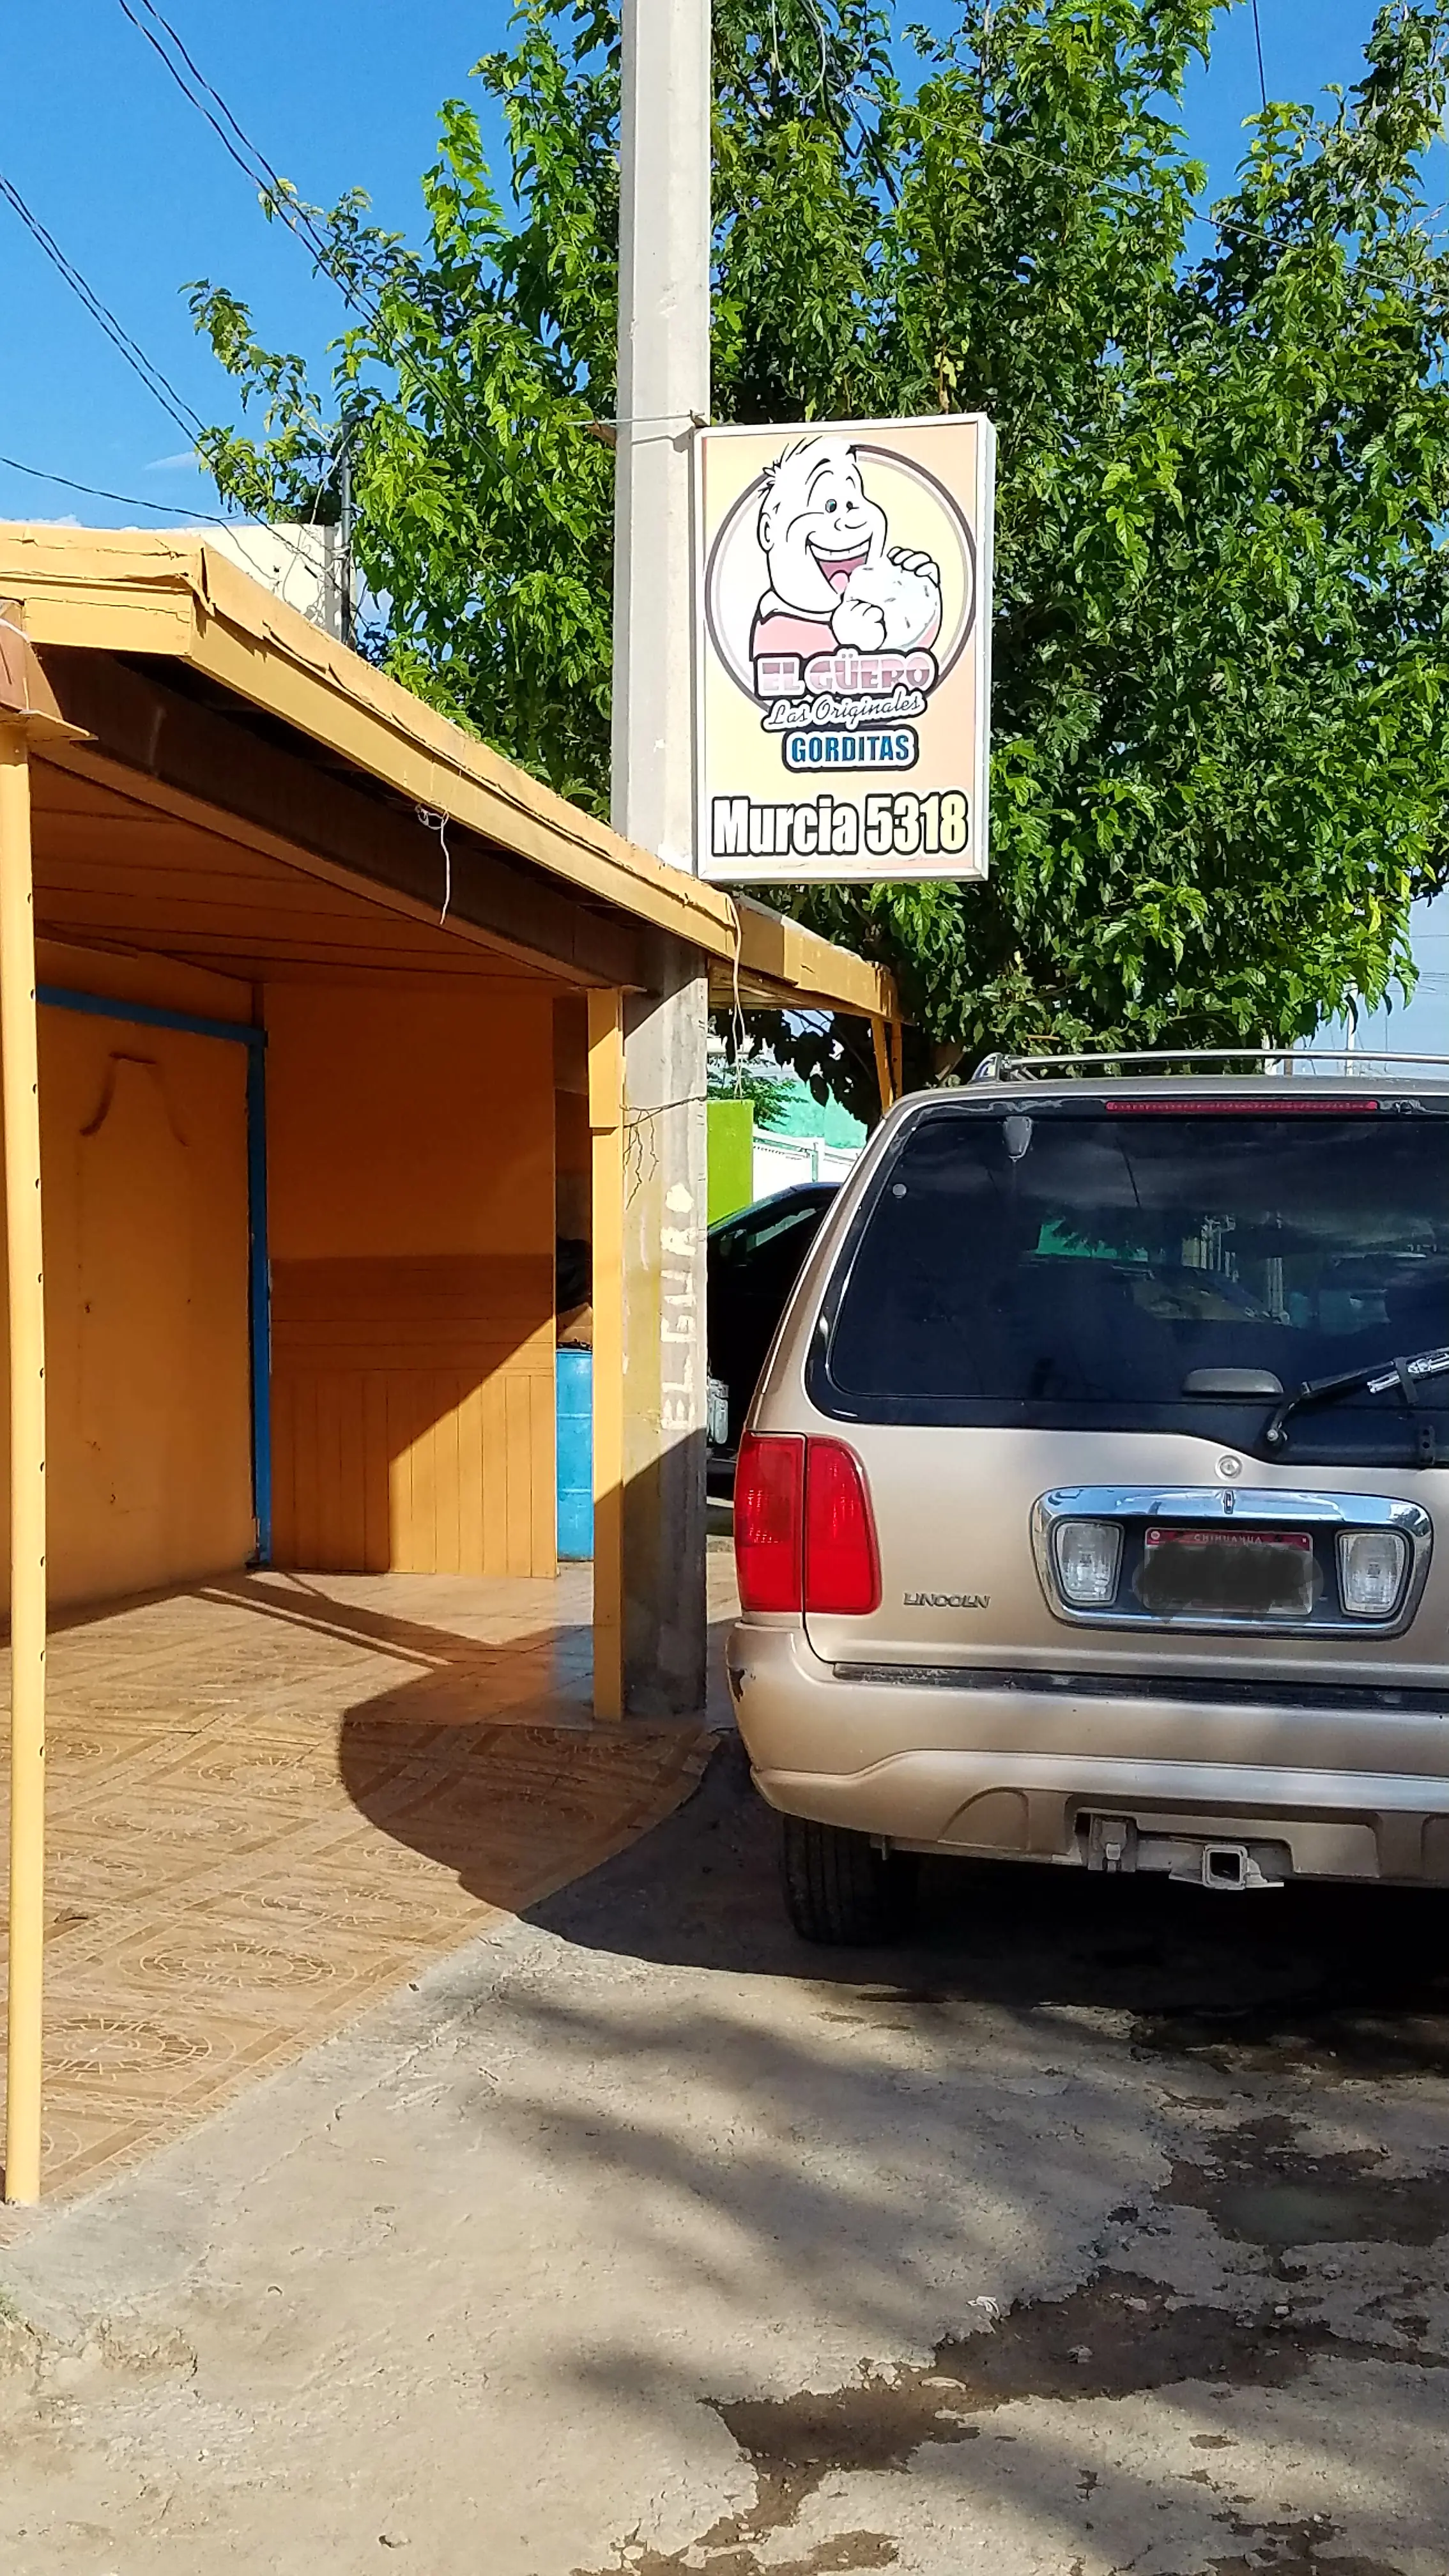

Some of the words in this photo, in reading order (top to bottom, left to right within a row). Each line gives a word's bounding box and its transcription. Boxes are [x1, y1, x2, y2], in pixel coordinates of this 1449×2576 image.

[762, 661, 801, 691] EL
[808, 653, 931, 691] GÜERO
[769, 699, 809, 725] Las
[813, 690, 922, 728] Originales
[791, 733, 910, 763] GORDITAS
[712, 795, 859, 857] Murcia
[864, 791, 969, 855] 5318
[661, 1354, 696, 1430] EL
[903, 1591, 991, 1609] LINCOLN
